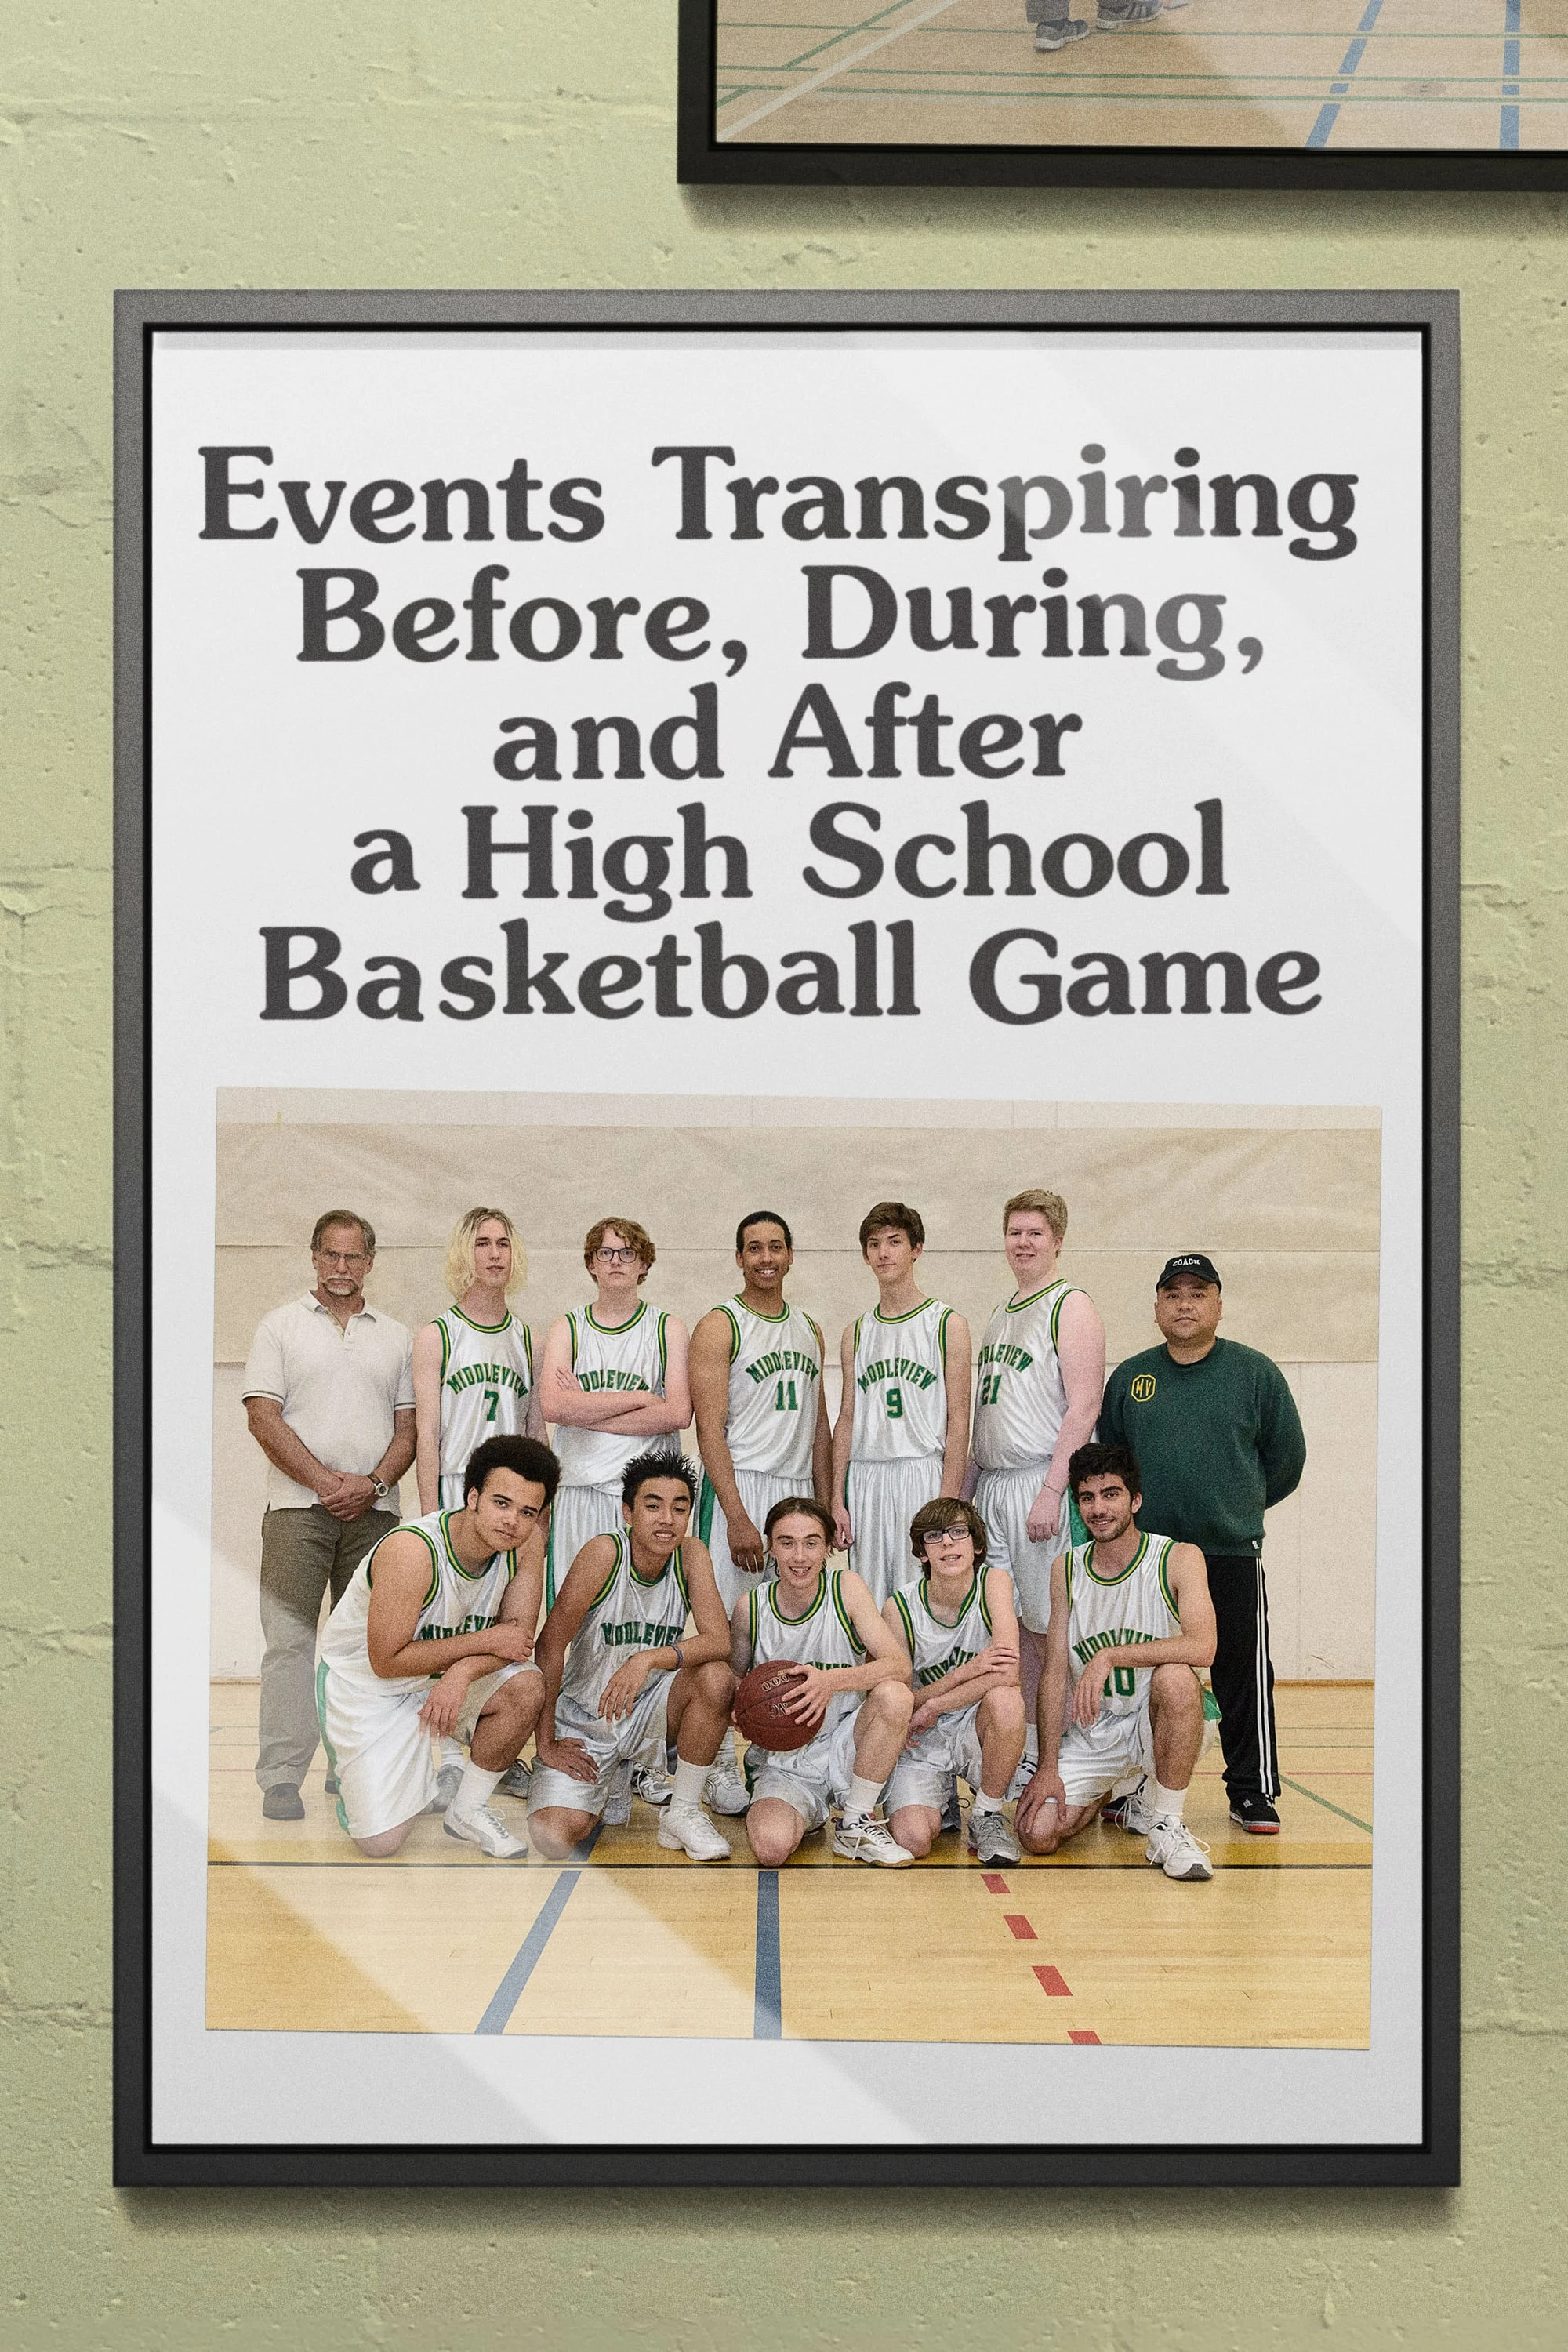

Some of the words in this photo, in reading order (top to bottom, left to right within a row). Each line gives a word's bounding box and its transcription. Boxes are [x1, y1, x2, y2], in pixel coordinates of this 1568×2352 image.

[198, 446, 604, 545] Events
[652, 444, 1359, 562] Transpiring
[296, 564, 749, 677] Before,
[801, 565, 1264, 681] During,
[493, 681, 724, 781] and
[768, 681, 1083, 779] After
[350, 829, 424, 898] a
[461, 801, 753, 923] High
[803, 798, 1230, 899] School
[259, 916, 921, 1022] Basketball
[969, 928, 1322, 1025] Game
[1172, 1258, 1200, 1266] COACH
[446, 1363, 529, 1399] MIDDLEVIEW
[744, 1350, 819, 1385] MIDDEVIEW
[857, 1356, 938, 1394] MDDLEVIEW
[484, 1388, 499, 1421] 7
[775, 1380, 798, 1411] 11
[886, 1388, 903, 1419] 9
[982, 1374, 1002, 1405] 21
